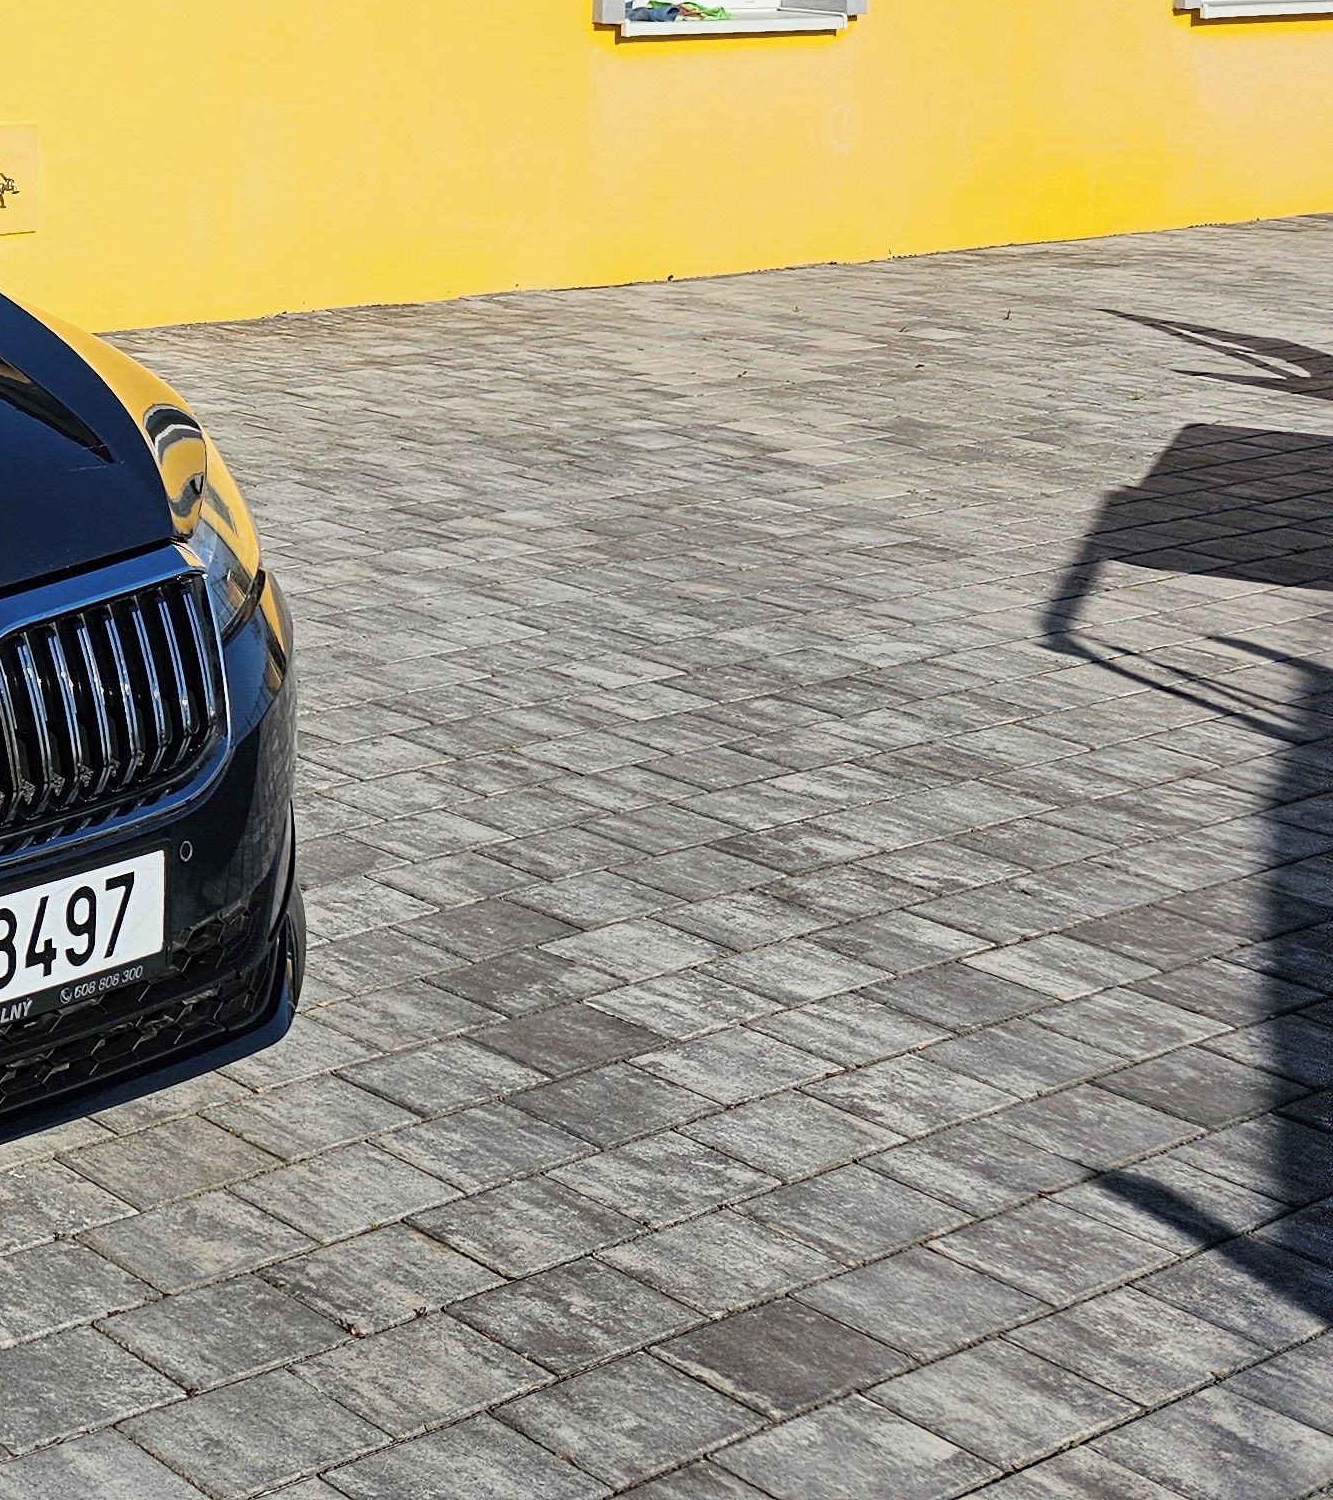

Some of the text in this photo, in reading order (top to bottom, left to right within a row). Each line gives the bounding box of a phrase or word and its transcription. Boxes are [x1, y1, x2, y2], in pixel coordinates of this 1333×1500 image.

[73, 965, 143, 999] 608 808 300
